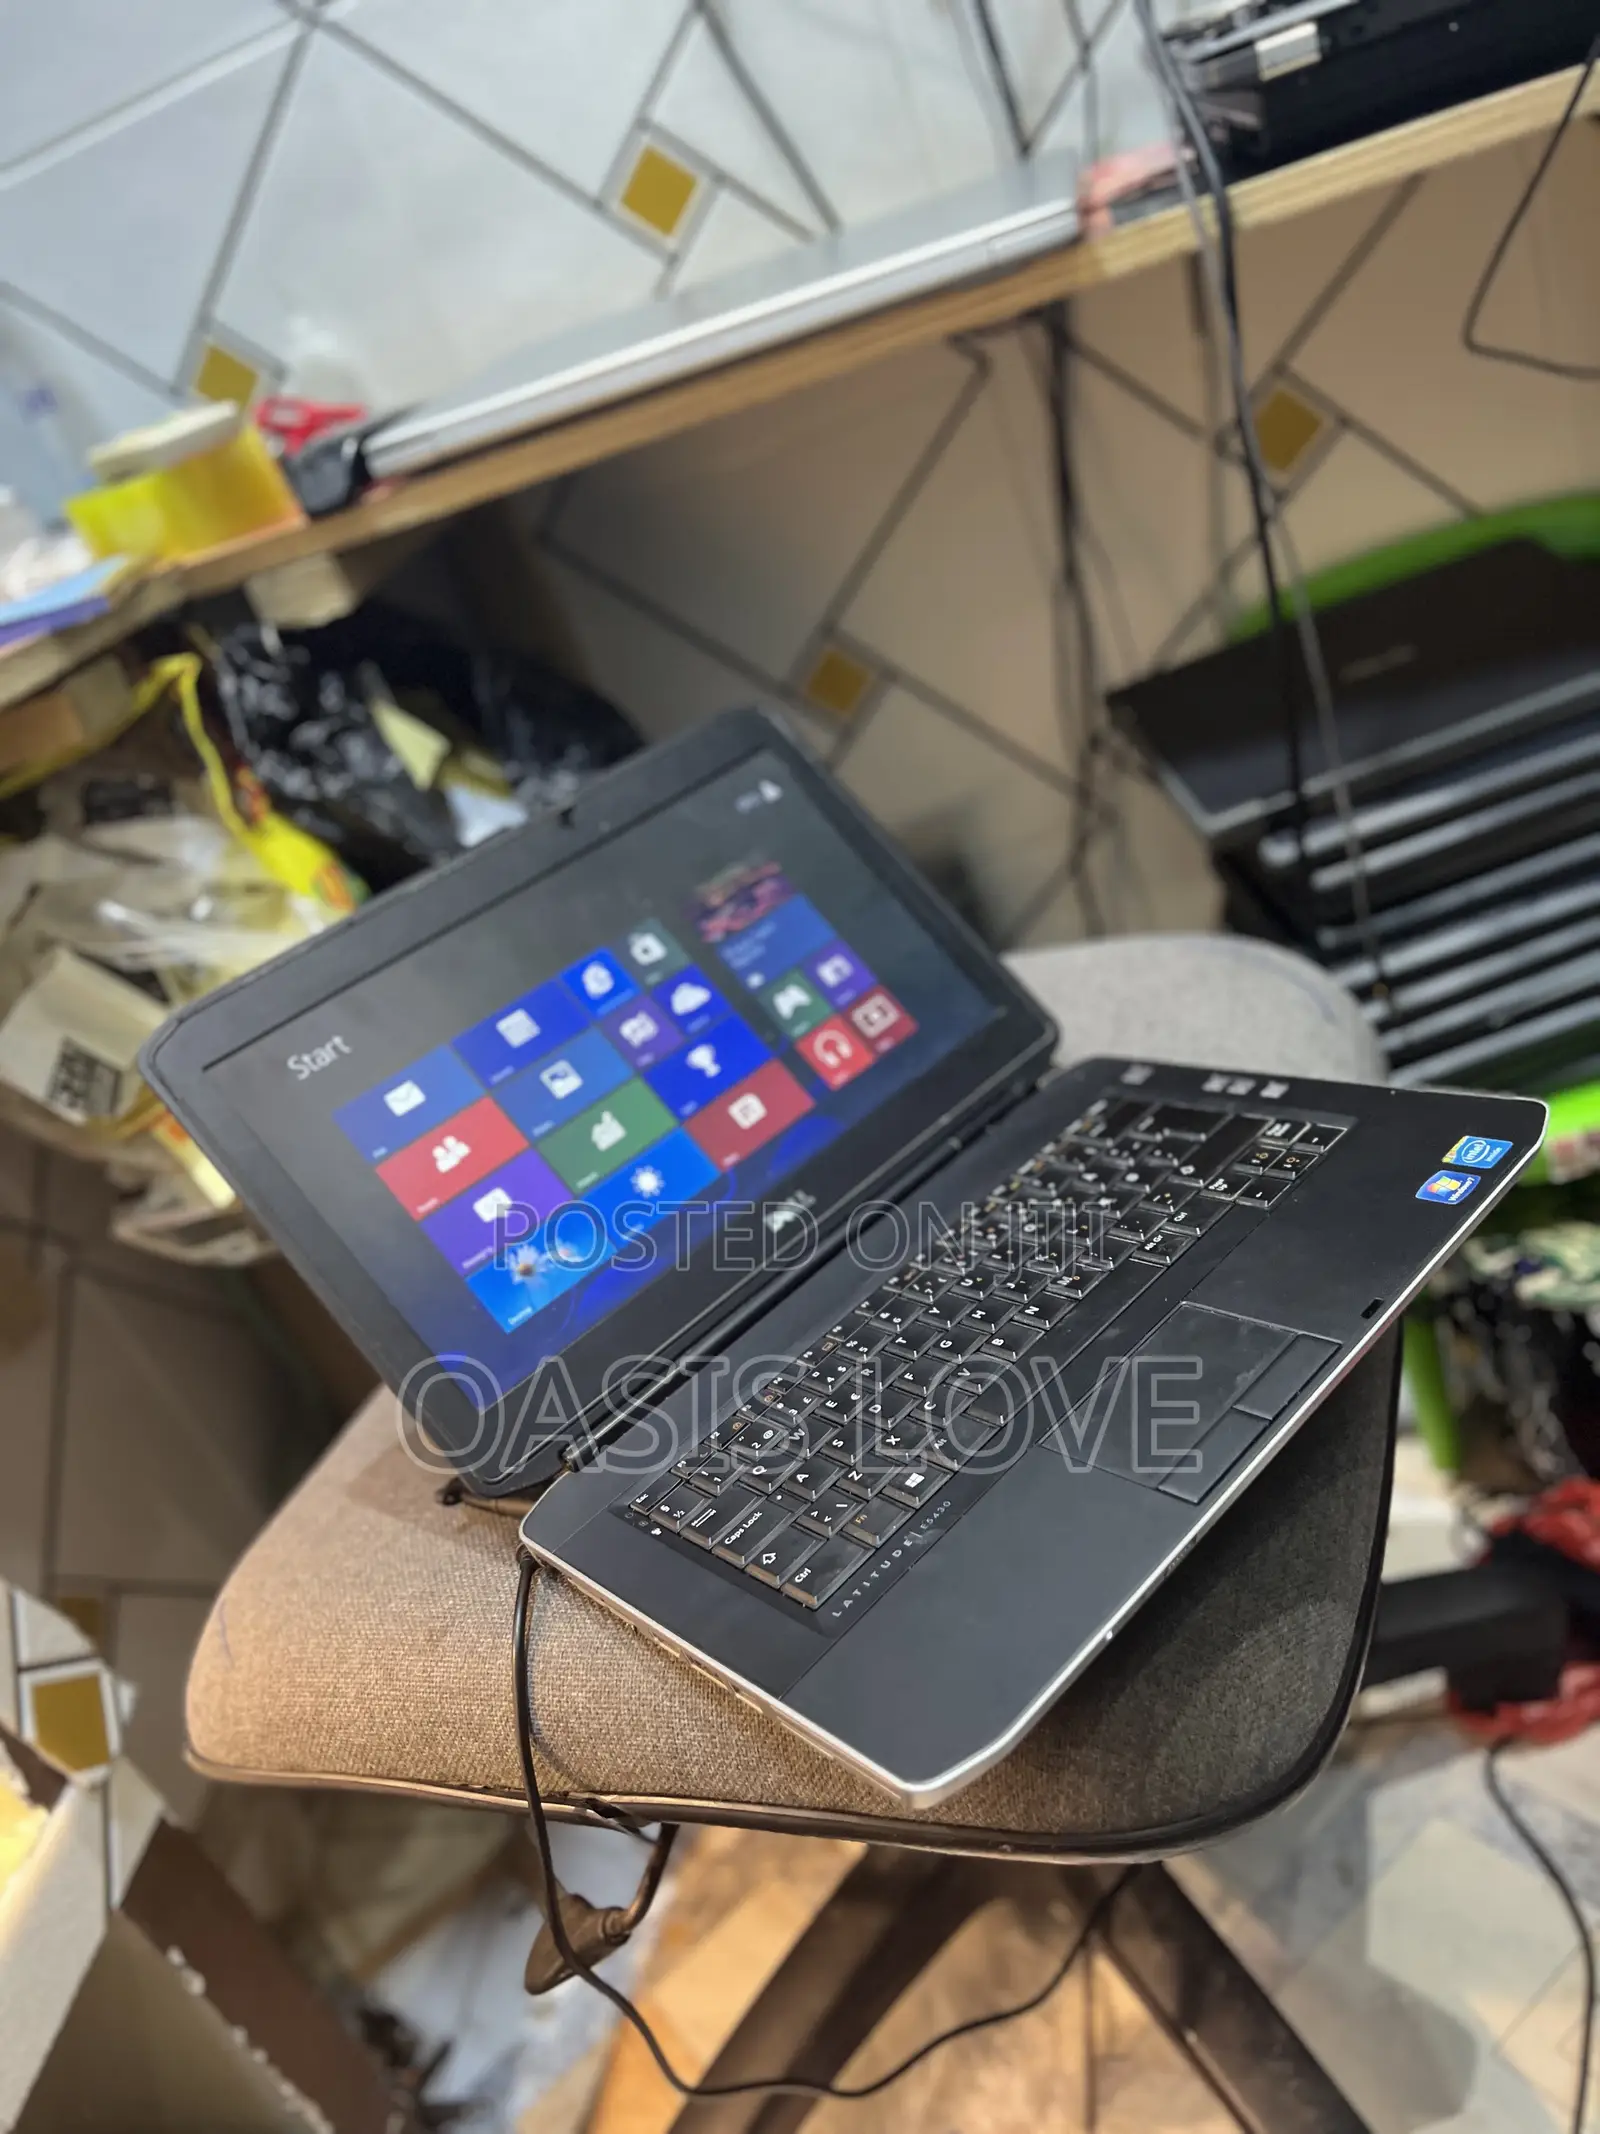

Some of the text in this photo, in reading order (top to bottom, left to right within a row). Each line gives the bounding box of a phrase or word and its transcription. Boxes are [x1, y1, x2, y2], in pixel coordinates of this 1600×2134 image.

[286, 1035, 352, 1080] Start
[1464, 1143, 1485, 1160] intel
[1174, 1211, 1188, 1222] Ctrl
[960, 1278, 974, 1287] U
[1056, 1275, 1073, 1286] M
[928, 1306, 940, 1314] Y
[971, 1310, 986, 1319] H
[1024, 1305, 1040, 1315] N
[892, 1316, 902, 1324] 6
[895, 1336, 907, 1345] T
[940, 1339, 953, 1349] G
[991, 1338, 1005, 1346] B
[860, 1367, 875, 1377] R
[903, 1372, 914, 1380] F
[957, 1367, 971, 1376] V
[825, 1400, 838, 1408] E
[868, 1404, 882, 1414] D
[924, 1401, 936, 1410] C
[788, 1428, 805, 1440] W
[832, 1439, 844, 1448] S
[885, 1434, 901, 1446] X
[752, 1465, 767, 1475] Q
[796, 1472, 810, 1483] A
[848, 1470, 863, 1481] Z
[855, 1513, 868, 1525] Fn
[724, 1511, 763, 1545] Caps Lock
[832, 1500, 951, 1618] LATITUDE E5430
[794, 1567, 812, 1583] Ctrl
